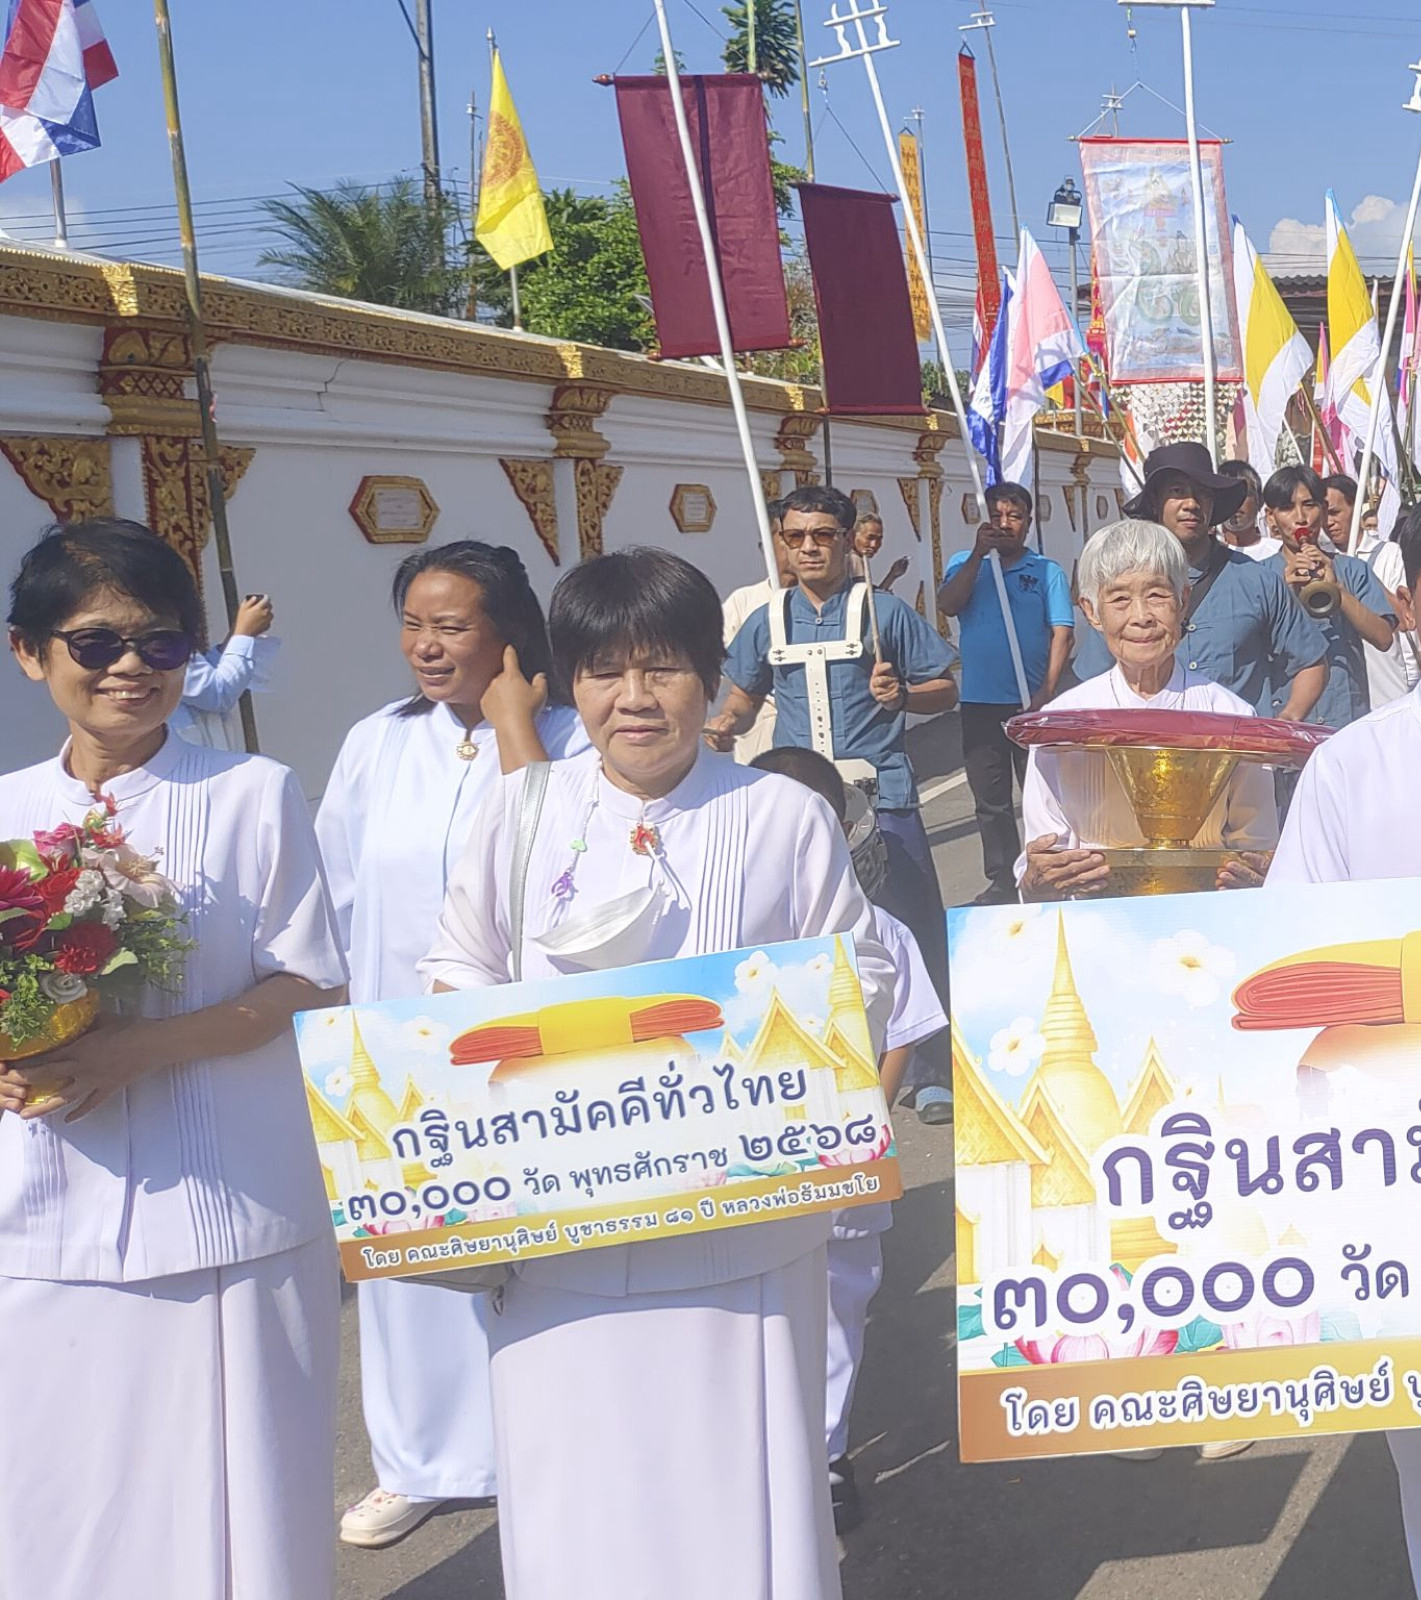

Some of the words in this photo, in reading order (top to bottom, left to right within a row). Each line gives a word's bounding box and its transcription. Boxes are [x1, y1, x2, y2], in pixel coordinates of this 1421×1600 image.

[392, 1064, 806, 1168] กฐินสามัคคีทั่วไทย
[348, 1176, 511, 1221] ๓๐,๐๐๐
[523, 1168, 560, 1195] วัด
[569, 1147, 728, 1195] พุทธศักราช
[739, 1114, 876, 1162] ๒๕๖๘
[362, 1247, 401, 1269] โดย
[406, 1224, 558, 1264] คณะศิษยานุศิษย์
[565, 1211, 658, 1246] บูชาธรรม
[665, 1211, 693, 1226] ๘๑
[699, 1200, 717, 1221] ปี
[722, 1174, 879, 1216] หลวงพ่อธัมมชโย
[993, 1257, 1315, 1334] ๓๐,๐๐๐
[1340, 1244, 1409, 1301] วัด
[1005, 1393, 1075, 1430] โดย
[1094, 1361, 1390, 1424] คณะศิษยานุศิษย์
